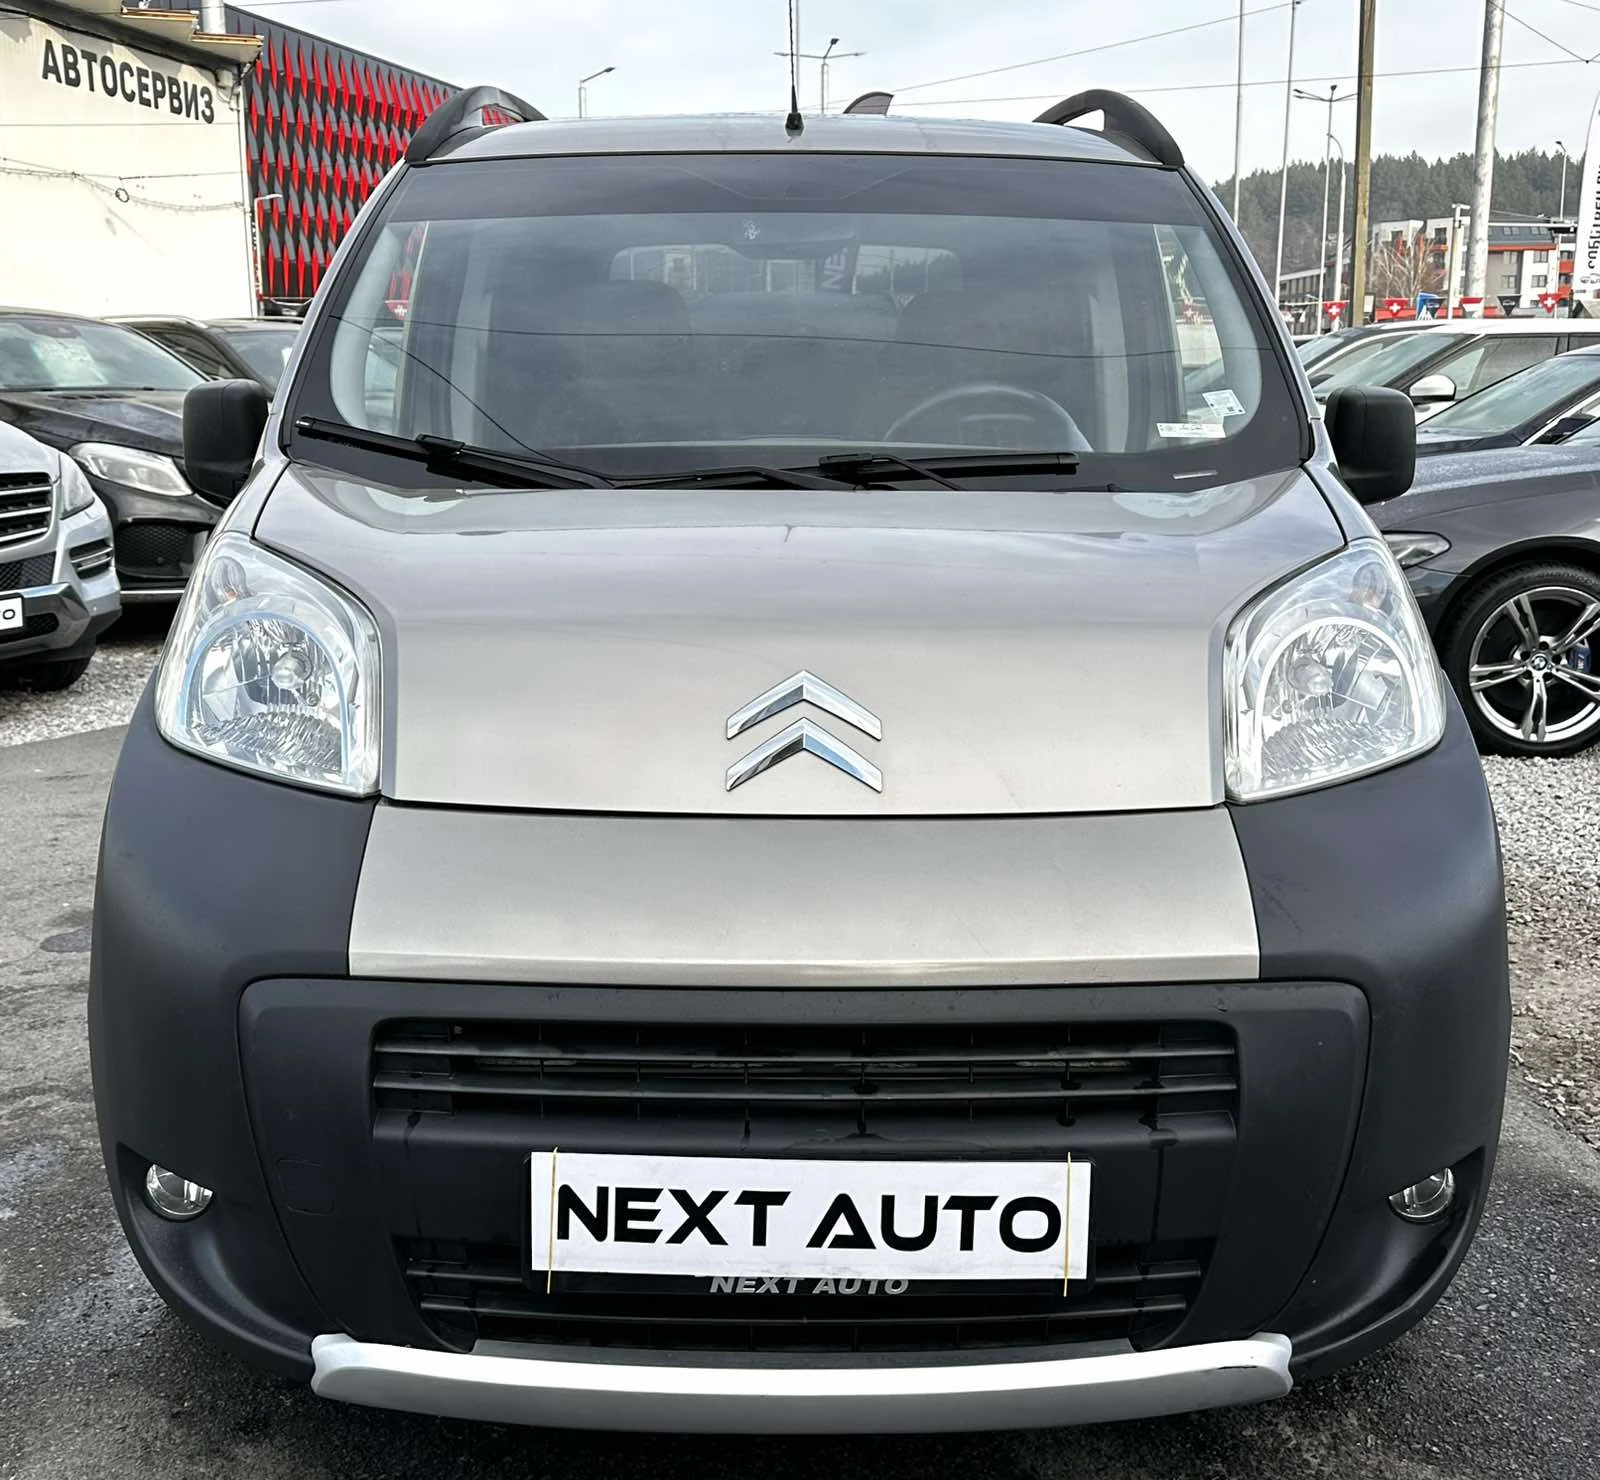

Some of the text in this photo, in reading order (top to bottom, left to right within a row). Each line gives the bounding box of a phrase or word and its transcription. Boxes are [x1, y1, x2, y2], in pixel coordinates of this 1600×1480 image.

[42, 39, 214, 124] АВТОСЕРВИЗ
[557, 1184, 1062, 1253] NEXT AUTO
[709, 1276, 909, 1295] NEXT AUTO
